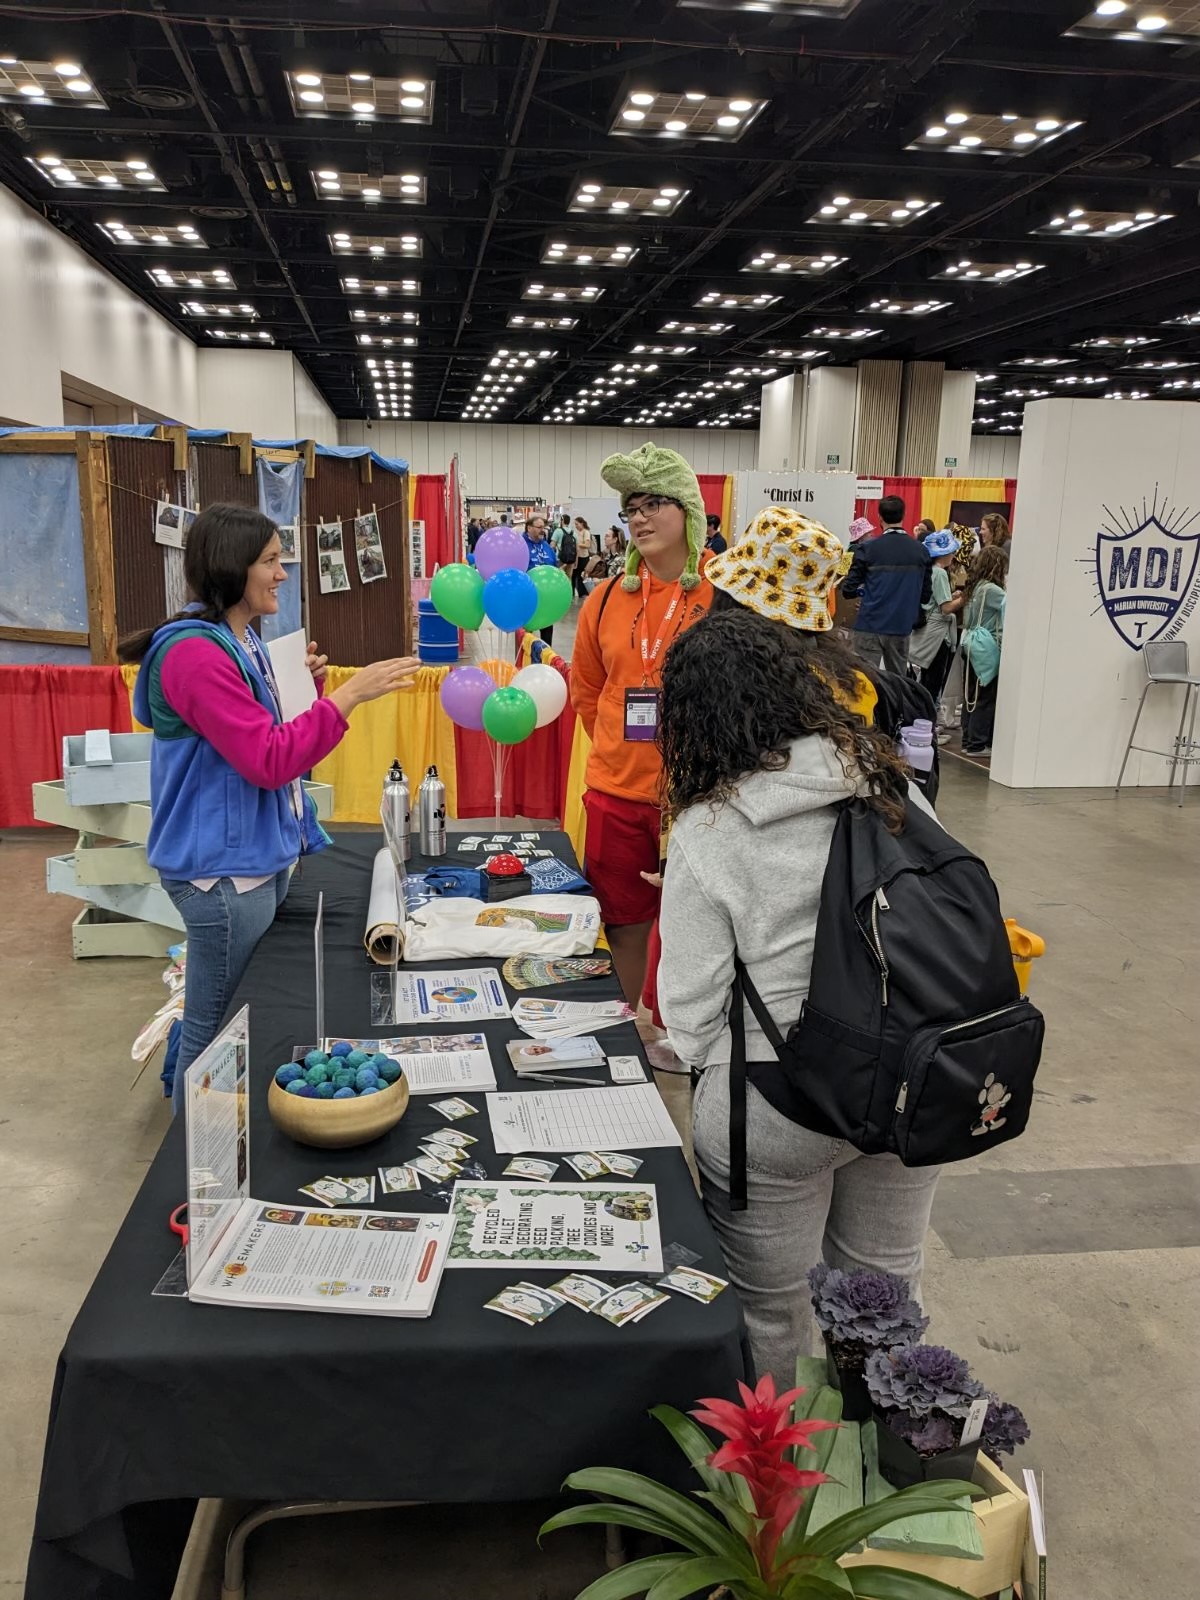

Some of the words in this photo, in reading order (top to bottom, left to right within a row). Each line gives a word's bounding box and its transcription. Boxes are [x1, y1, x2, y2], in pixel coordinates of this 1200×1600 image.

[805, 488, 814, 502] is
[1108, 546, 1183, 592] MDI
[1114, 601, 1136, 612] MARIAN
[1137, 600, 1169, 612] UNIVERSITY
[584, 1202, 597, 1215] AND
[482, 1208, 500, 1245] RECYCLED
[500, 1218, 515, 1245] PALLET
[516, 1200, 534, 1245] DECORATING,
[550, 1213, 565, 1246] PACKING,
[584, 1216, 598, 1246] COOKIES
[533, 1227, 548, 1245] SEED
[567, 1228, 581, 1246] TREE
[601, 1224, 615, 1247] MORE!
